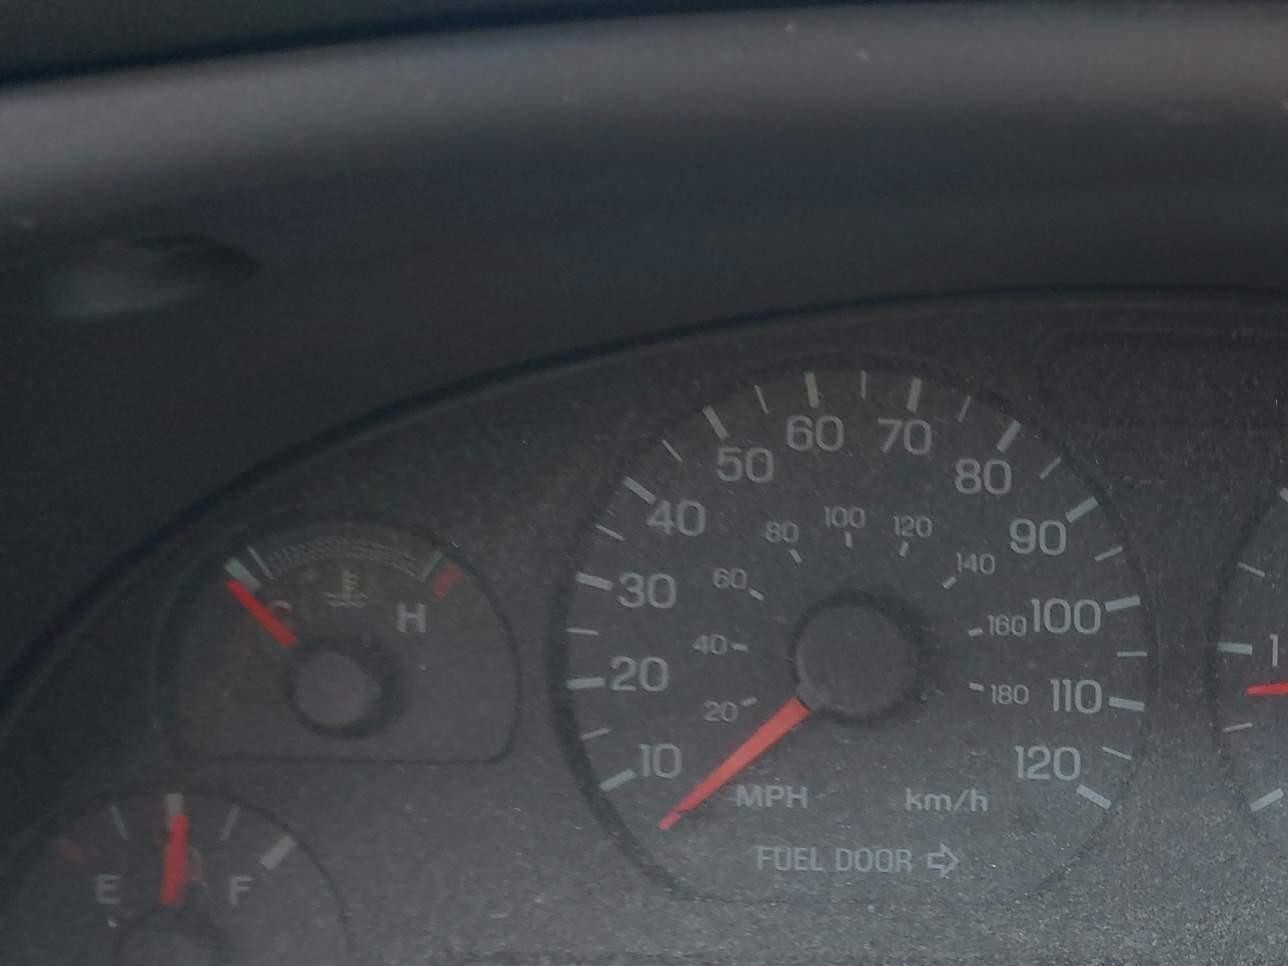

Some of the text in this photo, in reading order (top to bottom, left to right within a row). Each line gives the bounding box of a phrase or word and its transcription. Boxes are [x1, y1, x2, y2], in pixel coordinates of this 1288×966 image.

[786, 416, 845, 451] 60
[878, 418, 933, 454] 70
[716, 448, 774, 483] 50
[954, 460, 1013, 494] 80
[647, 501, 706, 537] 40
[766, 522, 799, 543] 80
[823, 508, 866, 529] 100
[893, 516, 933, 539] 120
[1009, 519, 1067, 555] 90
[957, 553, 996, 575] 140
[619, 573, 676, 608] 30
[713, 569, 747, 590] 60
[397, 602, 427, 633] H
[987, 615, 1027, 636] 160
[1032, 599, 1100, 635] 100
[693, 634, 728, 655] 40
[1270, 634, 1280, 666] 1
[611, 658, 669, 693] 20
[990, 684, 1029, 705] 180
[1050, 679, 1101, 714] 110
[704, 701, 738, 723] 20
[641, 744, 682, 779] 10
[1014, 746, 1081, 781] 120
[736, 785, 808, 809] MPH
[905, 787, 988, 812] km/h
[757, 847, 913, 873] FUEL DOOR
[96, 874, 121, 904] E
[229, 876, 252, 905] F
